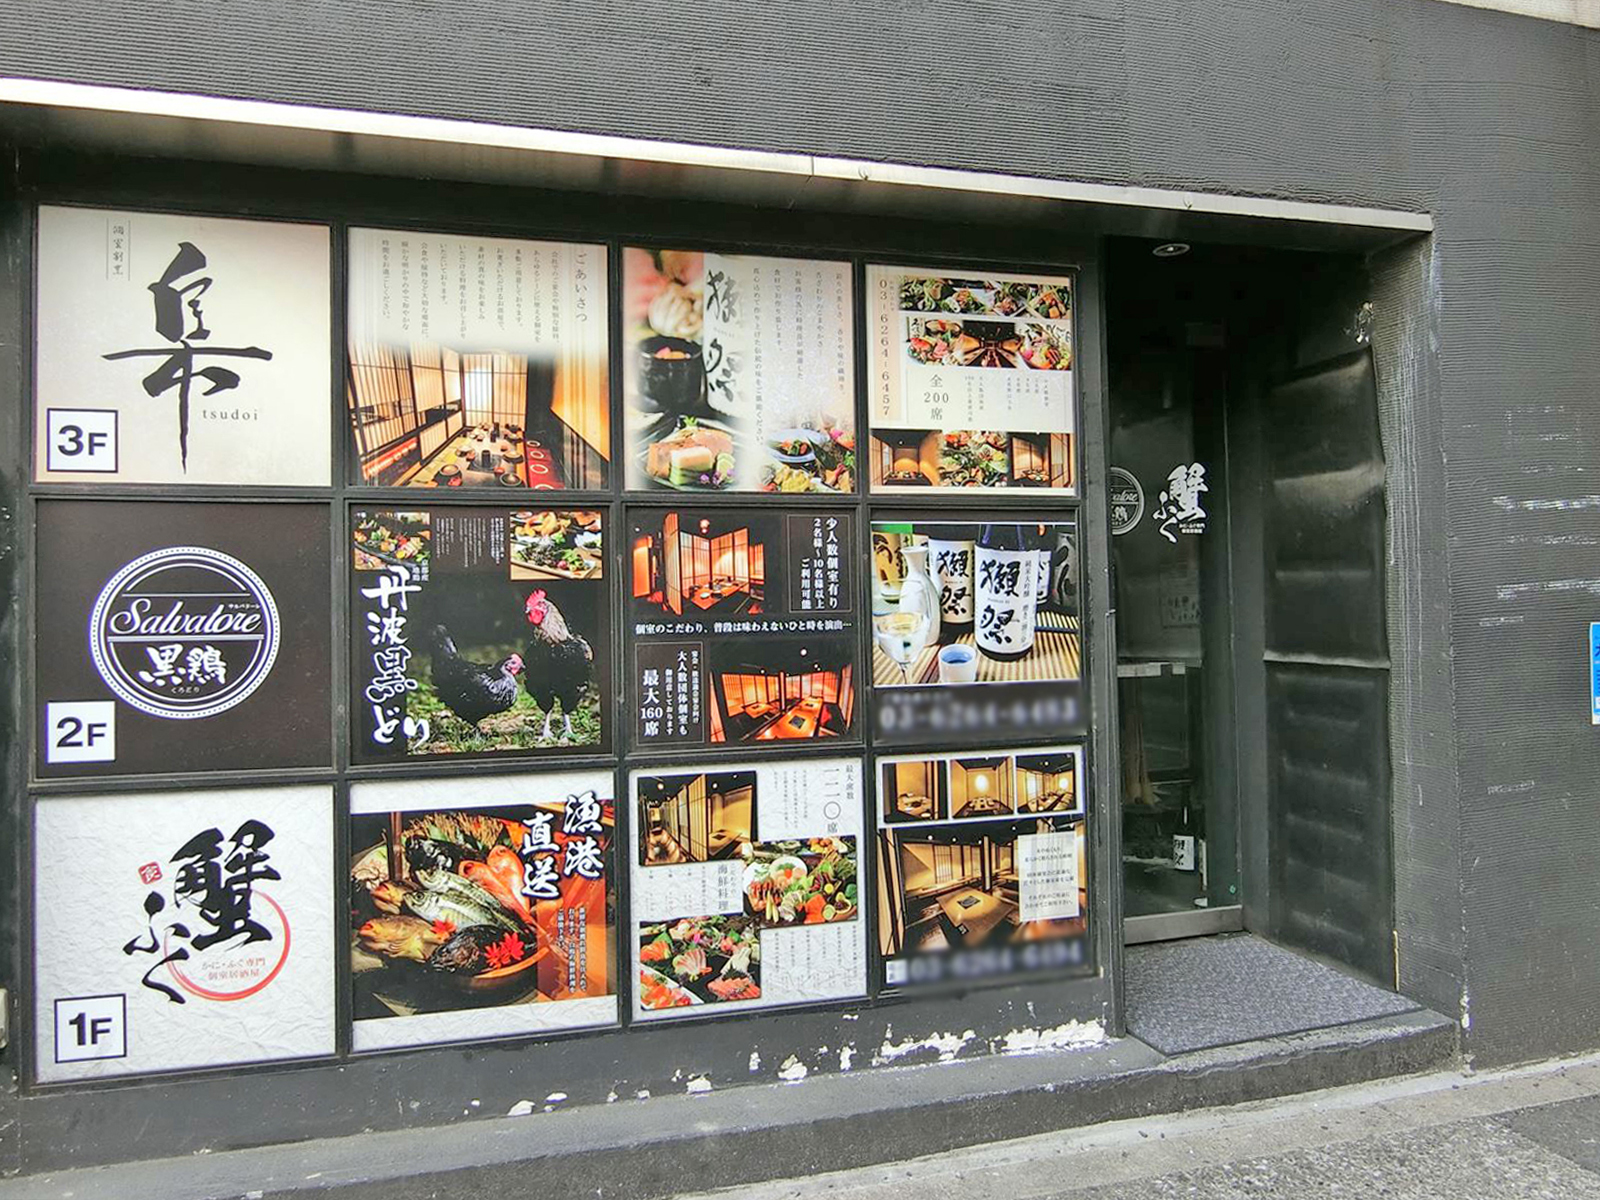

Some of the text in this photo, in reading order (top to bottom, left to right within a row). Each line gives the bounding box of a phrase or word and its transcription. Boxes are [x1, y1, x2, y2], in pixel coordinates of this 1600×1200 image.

[575, 252, 588, 323] ごあいさつ
[57, 425, 108, 456] 3F
[202, 409, 258, 421] tsudoi
[801, 558, 811, 610] ご利用可能
[825, 516, 839, 609] 少人数個室有り
[109, 598, 262, 634] Salvatore
[980, 559, 1021, 644] 獺祭
[138, 643, 228, 686] 黒鶏
[361, 564, 431, 750] 丹波黒どり
[56, 716, 107, 748] 2F
[640, 669, 663, 736] 最大160席
[521, 812, 560, 899] 直送
[563, 791, 604, 878] 漁港
[69, 1012, 112, 1046] 1F
